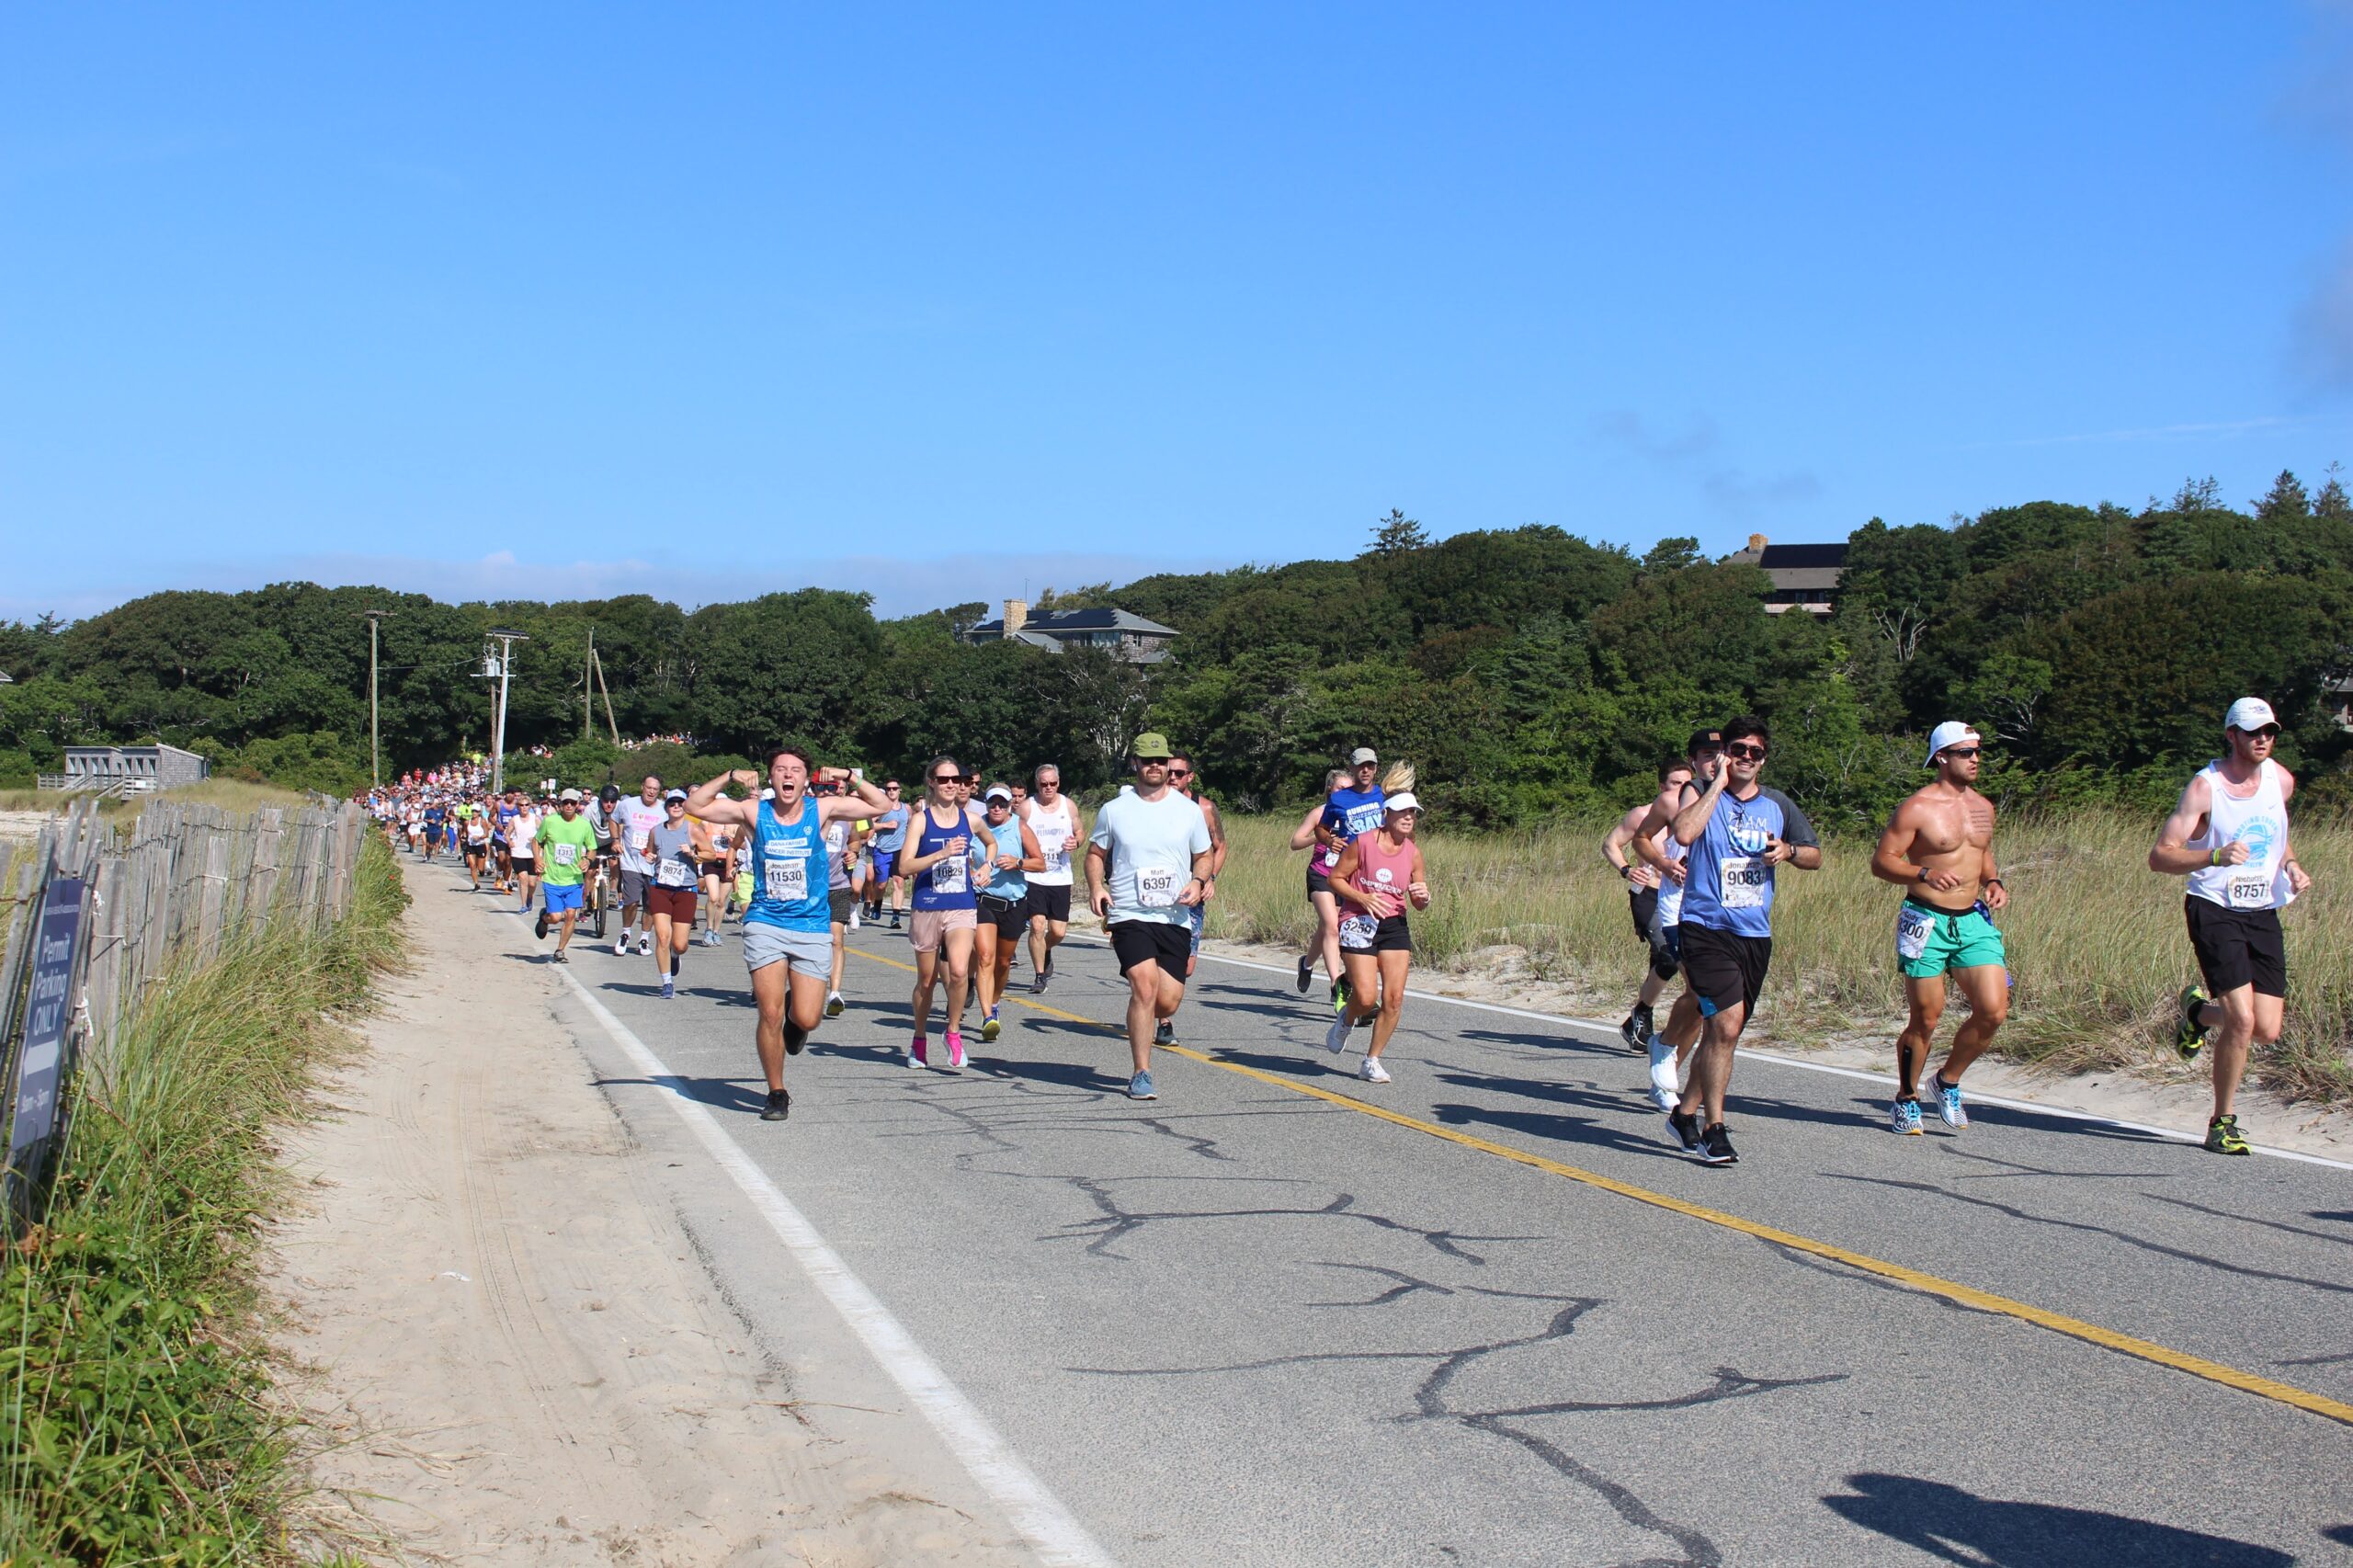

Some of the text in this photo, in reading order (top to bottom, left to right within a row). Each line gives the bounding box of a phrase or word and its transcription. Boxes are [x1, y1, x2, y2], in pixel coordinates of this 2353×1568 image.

[1347, 802, 1380, 815] RUNNING
[1353, 814, 1382, 834] BAY
[765, 846, 785, 855] CANCER
[663, 865, 682, 877] 9874
[770, 870, 802, 882] 11530
[937, 867, 963, 878] 10829
[1727, 870, 1761, 886] 9083
[1142, 876, 1172, 890] 6397
[2234, 883, 2266, 899] 8757
[1343, 920, 1372, 935] 5259
[41, 932, 70, 964] Permit
[34, 968, 68, 1002] Parking
[33, 1002, 61, 1036] ONLY
